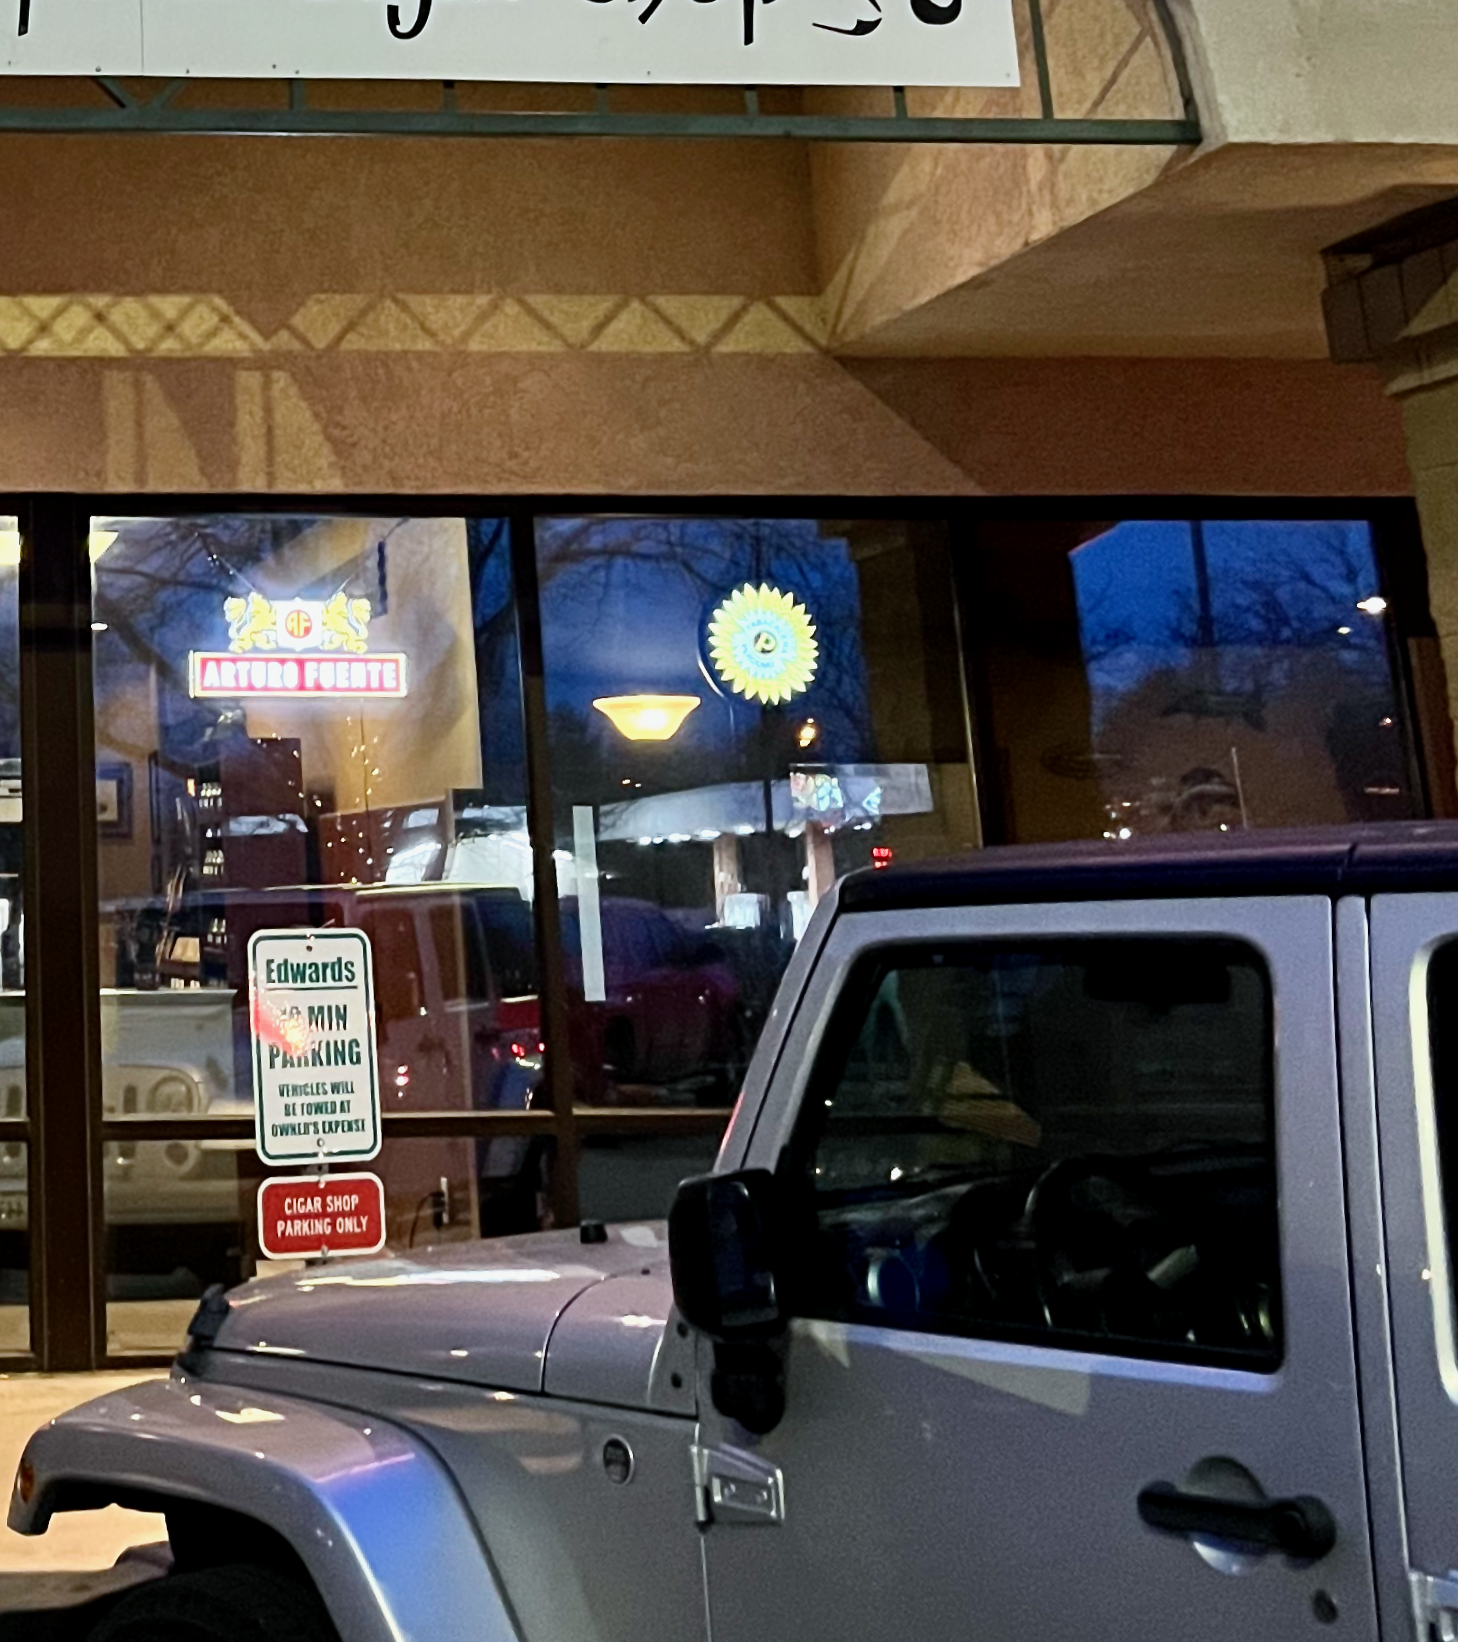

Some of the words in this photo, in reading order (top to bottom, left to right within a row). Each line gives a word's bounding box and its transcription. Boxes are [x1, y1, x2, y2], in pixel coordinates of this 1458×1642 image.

[203, 660, 299, 689] ARTURO
[305, 661, 397, 689] FUENTE
[265, 956, 356, 985] Edwards
[307, 1003, 348, 1033] MIN
[278, 1081, 329, 1098] VEHICLES
[330, 1080, 356, 1095] WILL
[284, 1102, 298, 1117] BE
[301, 1100, 337, 1116] TOWED
[339, 1099, 351, 1114] AT
[271, 1120, 320, 1137] OWNER'S
[321, 1118, 366, 1134] EXPENSE
[284, 1196, 322, 1216] CIGAR
[326, 1194, 359, 1213] SHOP
[276, 1218, 332, 1239] PARKING
[335, 1215, 369, 1234] ONLY
